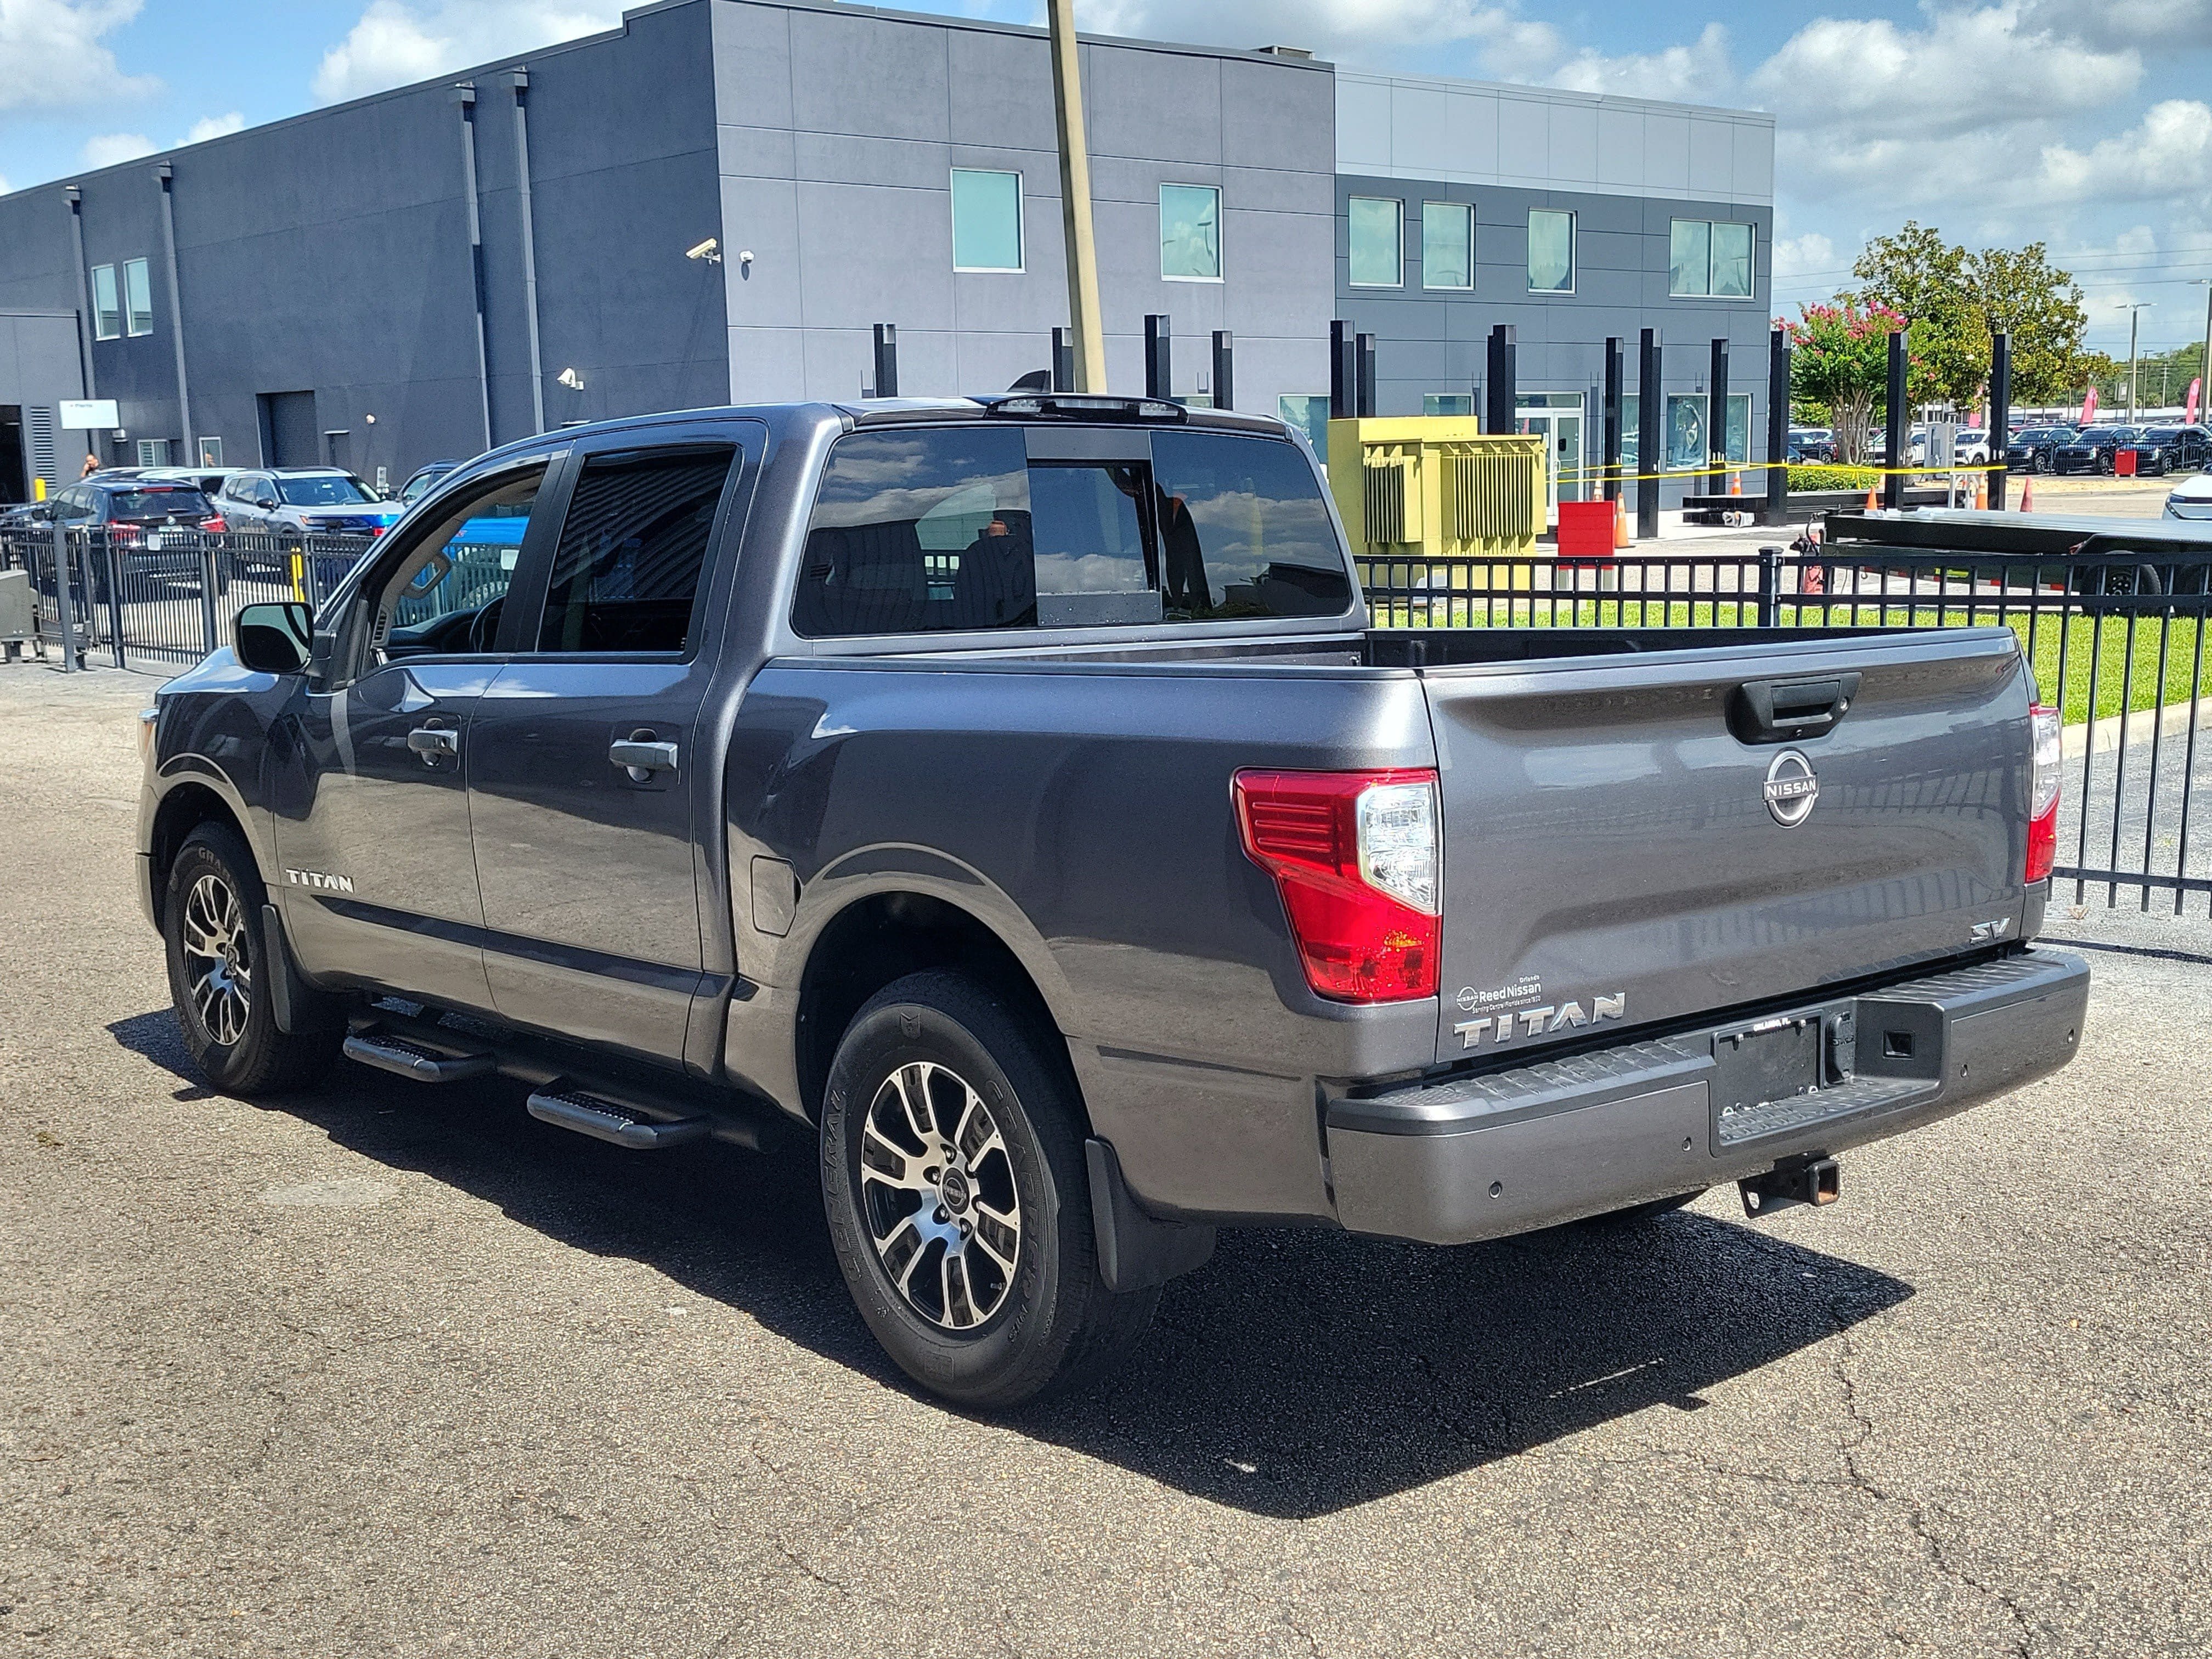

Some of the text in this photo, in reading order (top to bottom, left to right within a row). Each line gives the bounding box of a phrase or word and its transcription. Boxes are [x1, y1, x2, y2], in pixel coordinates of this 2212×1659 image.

[1766, 780, 1816, 798] NISSAN
[285, 868, 354, 893] TITAN
[1969, 917, 2011, 944] SV
[1479, 983, 1542, 1003] Reed Nissan
[1454, 992, 1626, 1050] TITAN
